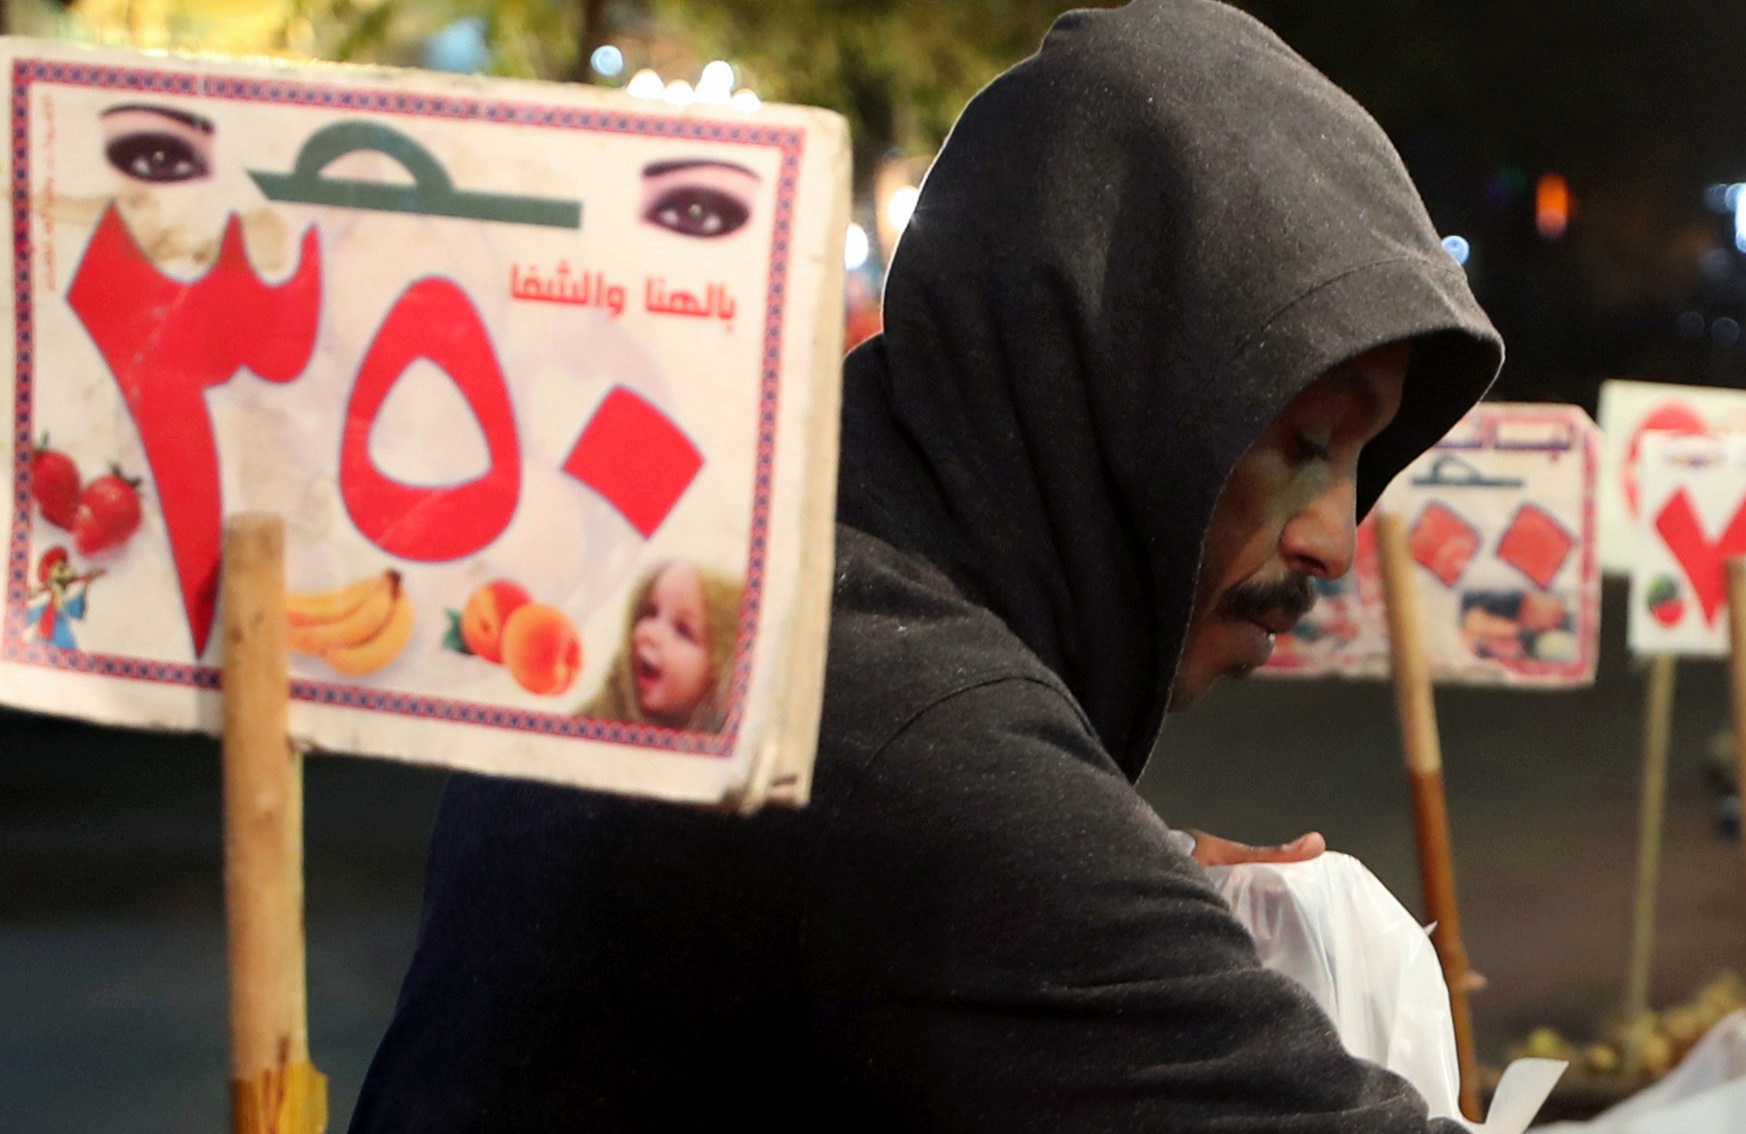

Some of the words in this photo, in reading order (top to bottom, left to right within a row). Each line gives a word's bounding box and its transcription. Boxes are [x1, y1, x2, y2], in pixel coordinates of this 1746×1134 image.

[510, 258, 626, 318] والشفا
[646, 275, 736, 332] بالهنا
[65, 202, 706, 660] ٣٥٠
